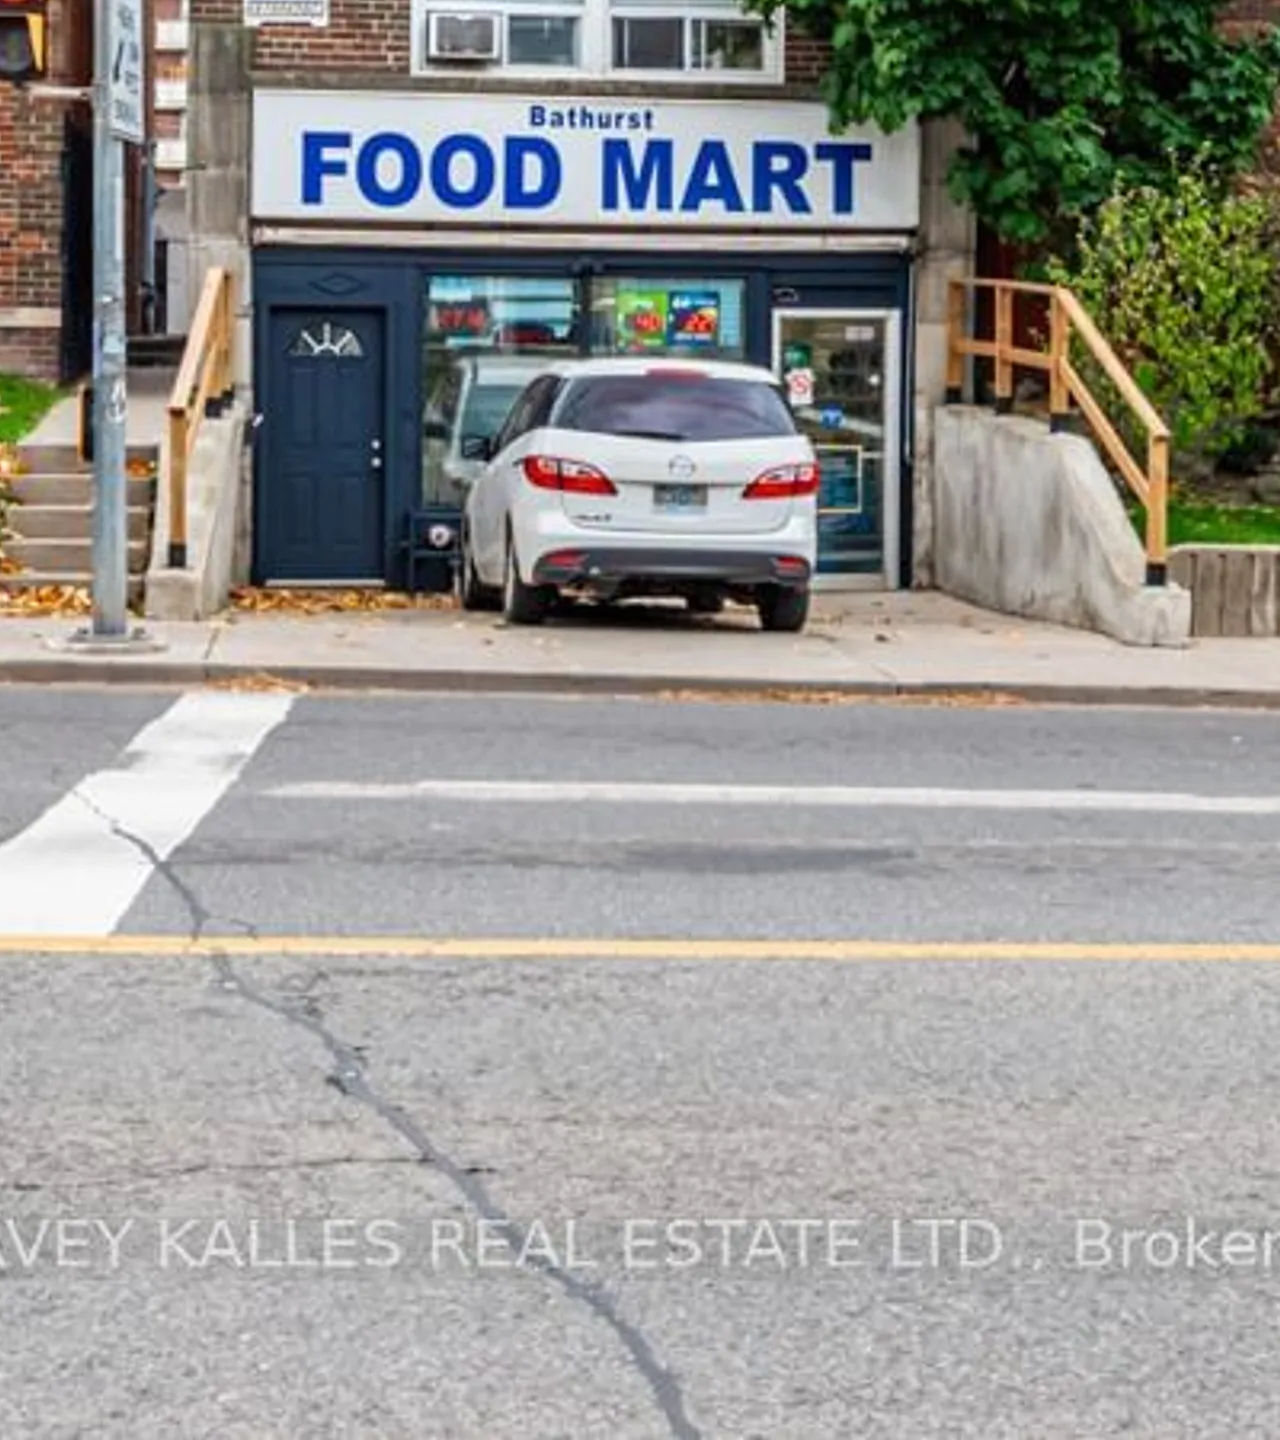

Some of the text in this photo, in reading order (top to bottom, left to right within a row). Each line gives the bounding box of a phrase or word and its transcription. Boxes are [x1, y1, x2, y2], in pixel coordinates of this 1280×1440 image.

[530, 105, 654, 130] Bathurst
[300, 131, 872, 215] FOOD MART
